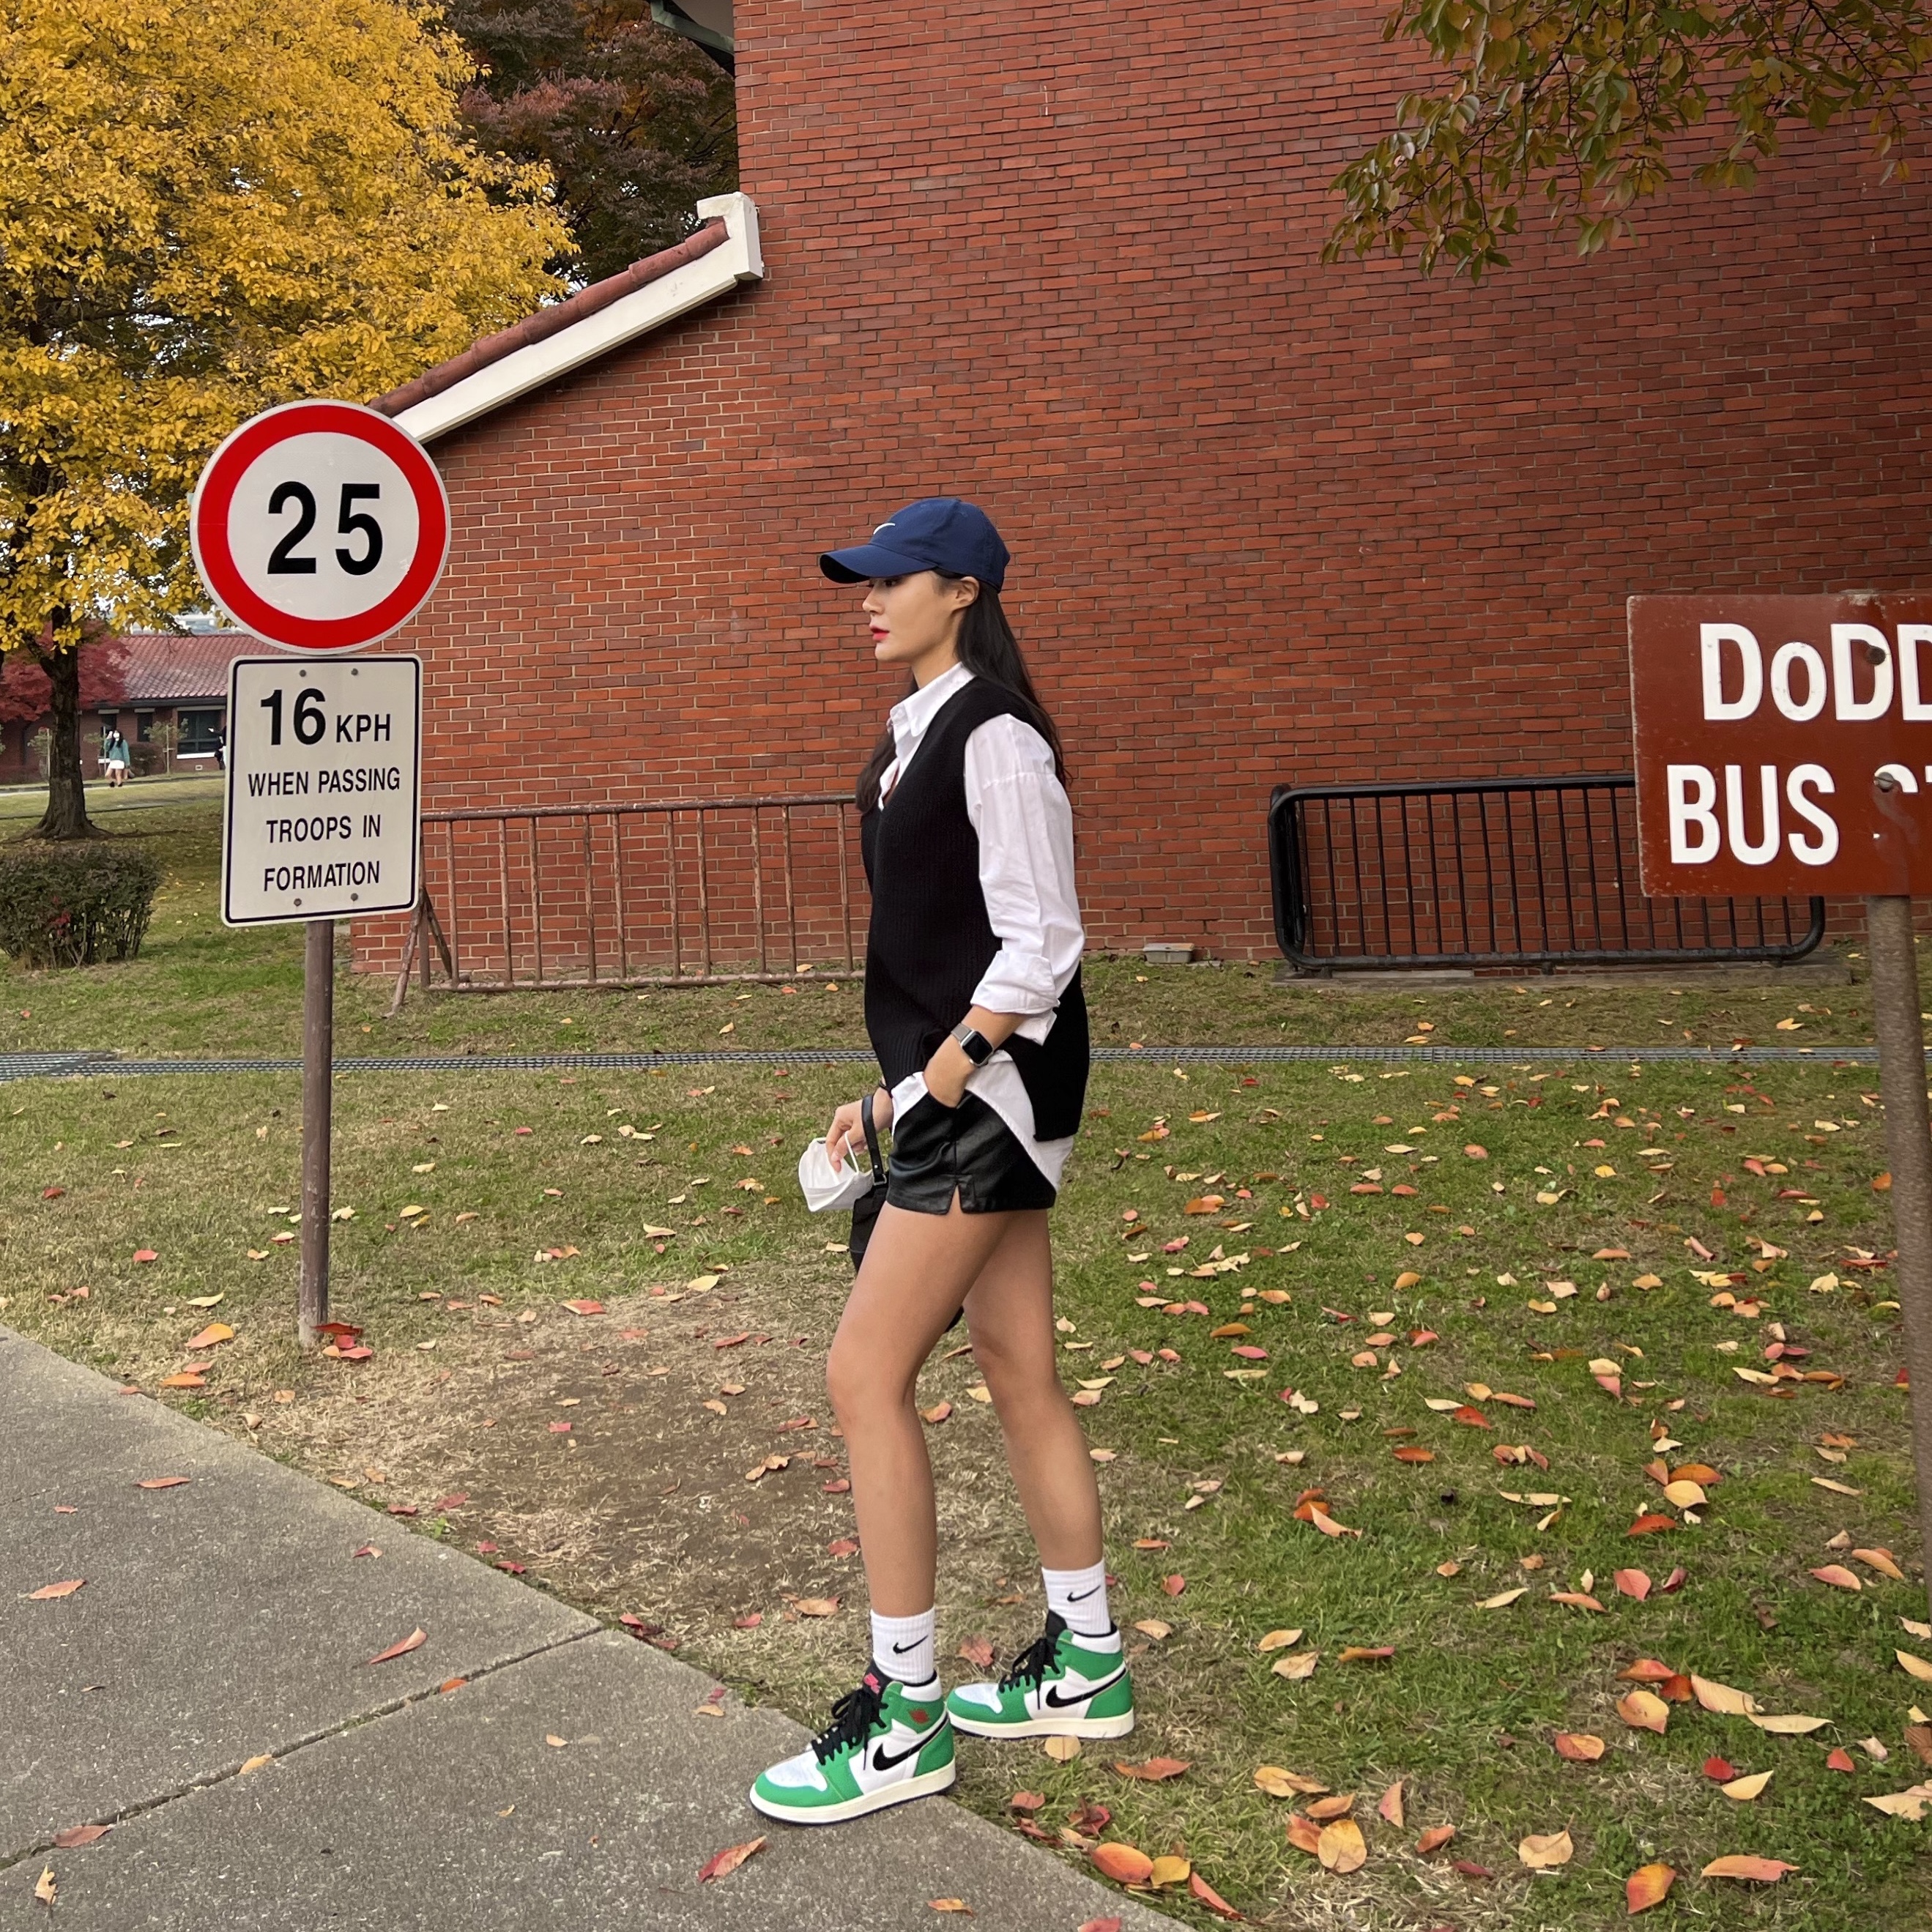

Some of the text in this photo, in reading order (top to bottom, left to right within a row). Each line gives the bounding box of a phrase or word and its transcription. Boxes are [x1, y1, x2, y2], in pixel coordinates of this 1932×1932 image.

[267, 481, 383, 575] 25
[260, 688, 391, 746] 16 KPH
[248, 767, 400, 797] WHEN PASSING
[266, 814, 381, 844] TROOPS IN
[1667, 763, 1839, 865] BUS
[264, 861, 380, 892] FORMATION
